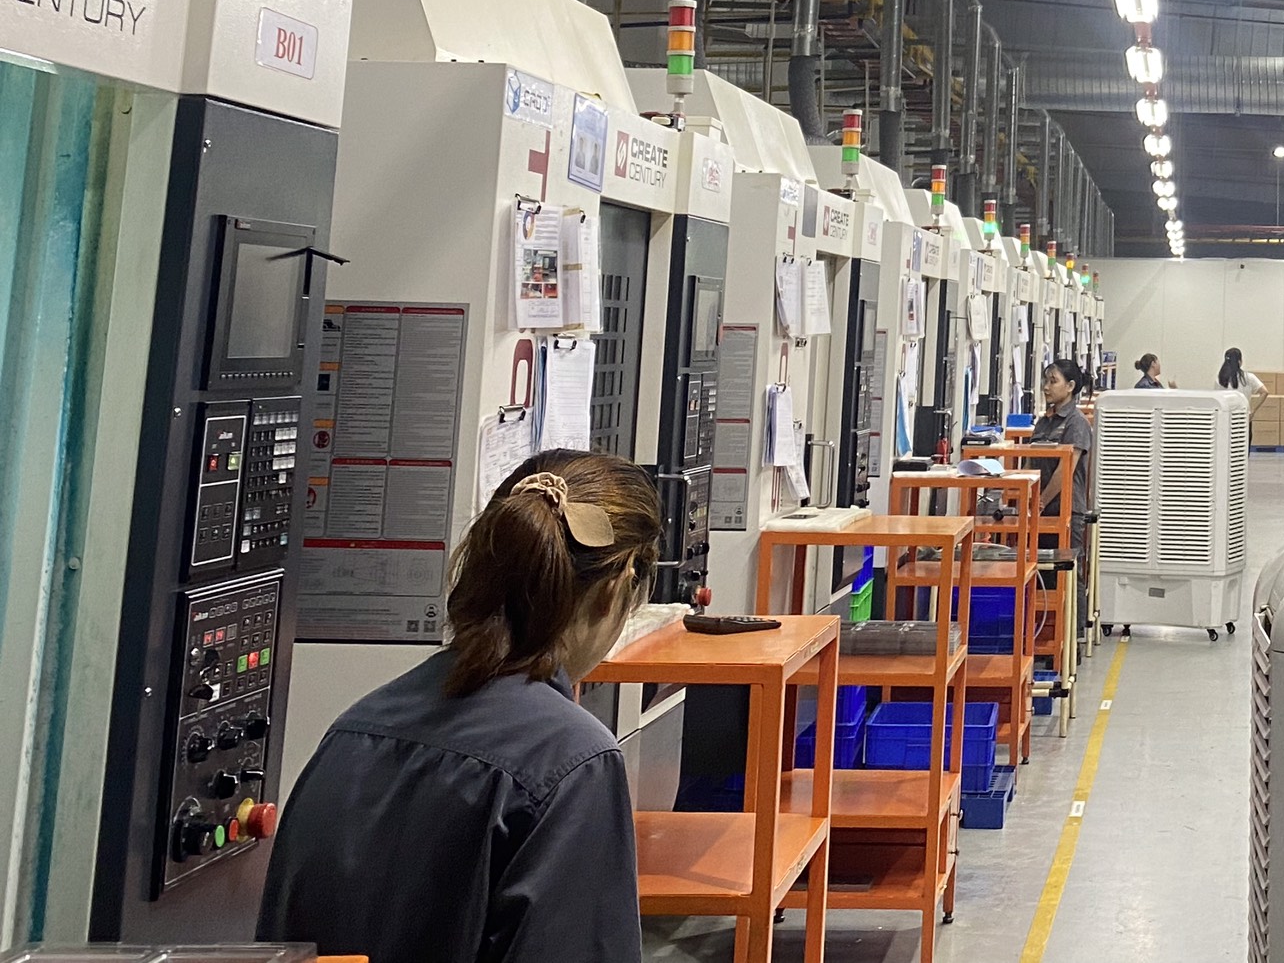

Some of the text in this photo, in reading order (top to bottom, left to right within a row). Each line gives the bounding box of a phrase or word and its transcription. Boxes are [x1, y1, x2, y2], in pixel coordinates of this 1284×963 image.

[274, 27, 304, 66] B01
[630, 137, 669, 169] CREATE
[629, 162, 667, 188] CENTURY
